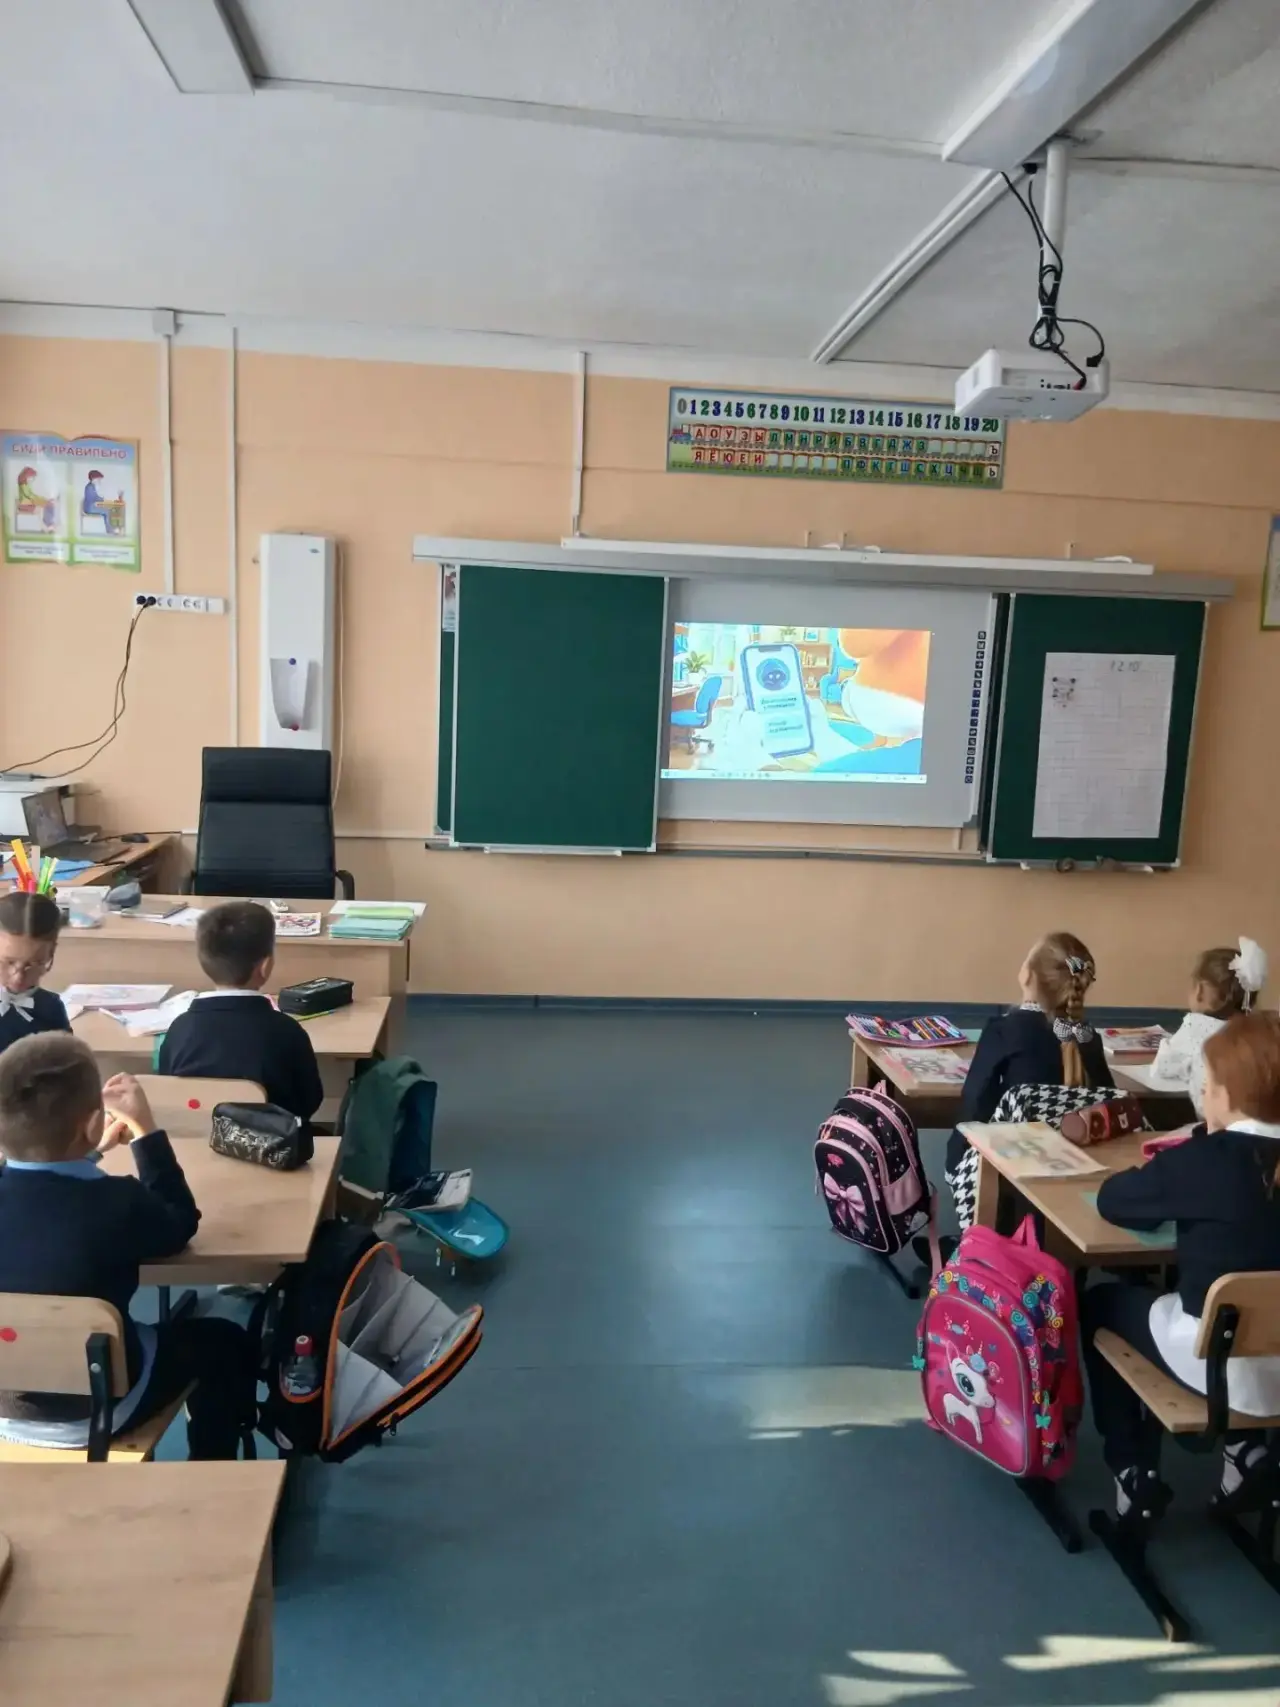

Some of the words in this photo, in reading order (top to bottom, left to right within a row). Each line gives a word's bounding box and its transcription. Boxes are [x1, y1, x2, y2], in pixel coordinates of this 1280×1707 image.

[678, 398, 686, 414] 0
[690, 400, 696, 415] 1
[701, 400, 710, 415] 2
[712, 401, 721, 416] 3
[724, 402, 732, 417] 4
[736, 402, 744, 418] 5
[747, 403, 756, 419] 6
[759, 404, 767, 419] 7
[770, 404, 778, 420] 8
[781, 405, 790, 420] 9
[794, 405, 810, 421] 10
[813, 407, 824, 422] 11
[830, 408, 846, 424] 12
[849, 409, 865, 425] 13
[869, 410, 884, 426] 14
[888, 411, 903, 427] 15
[907, 413, 922, 428] 16
[926, 414, 942, 429] 17
[945, 415, 960, 430] 18
[964, 417, 979, 431] 19
[982, 418, 999, 432] 20
[696, 428, 703, 438] А
[710, 429, 718, 438] О
[726, 430, 732, 439] У
[741, 431, 748, 440] Э
[755, 432, 764, 441] Ы
[786, 434, 793, 442] М
[801, 434, 807, 442] Н
[816, 435, 822, 444] Р
[845, 437, 852, 446] Б
[860, 438, 866, 447] В
[903, 440, 911, 449] Ж
[919, 441, 924, 449] З
[50, 445, 127, 459] ПРАВИЛЬНО
[695, 451, 702, 460] Я
[710, 448, 717, 461] Ё
[723, 453, 732, 462] Ю
[740, 454, 746, 463] Е
[755, 455, 762, 464] И
[844, 460, 850, 469] П
[857, 460, 866, 469] Ф
[872, 462, 880, 470] К
[901, 464, 908, 472] Ш
[916, 464, 923, 473] С
[932, 464, 938, 473] Х
[946, 465, 952, 476] Ц
